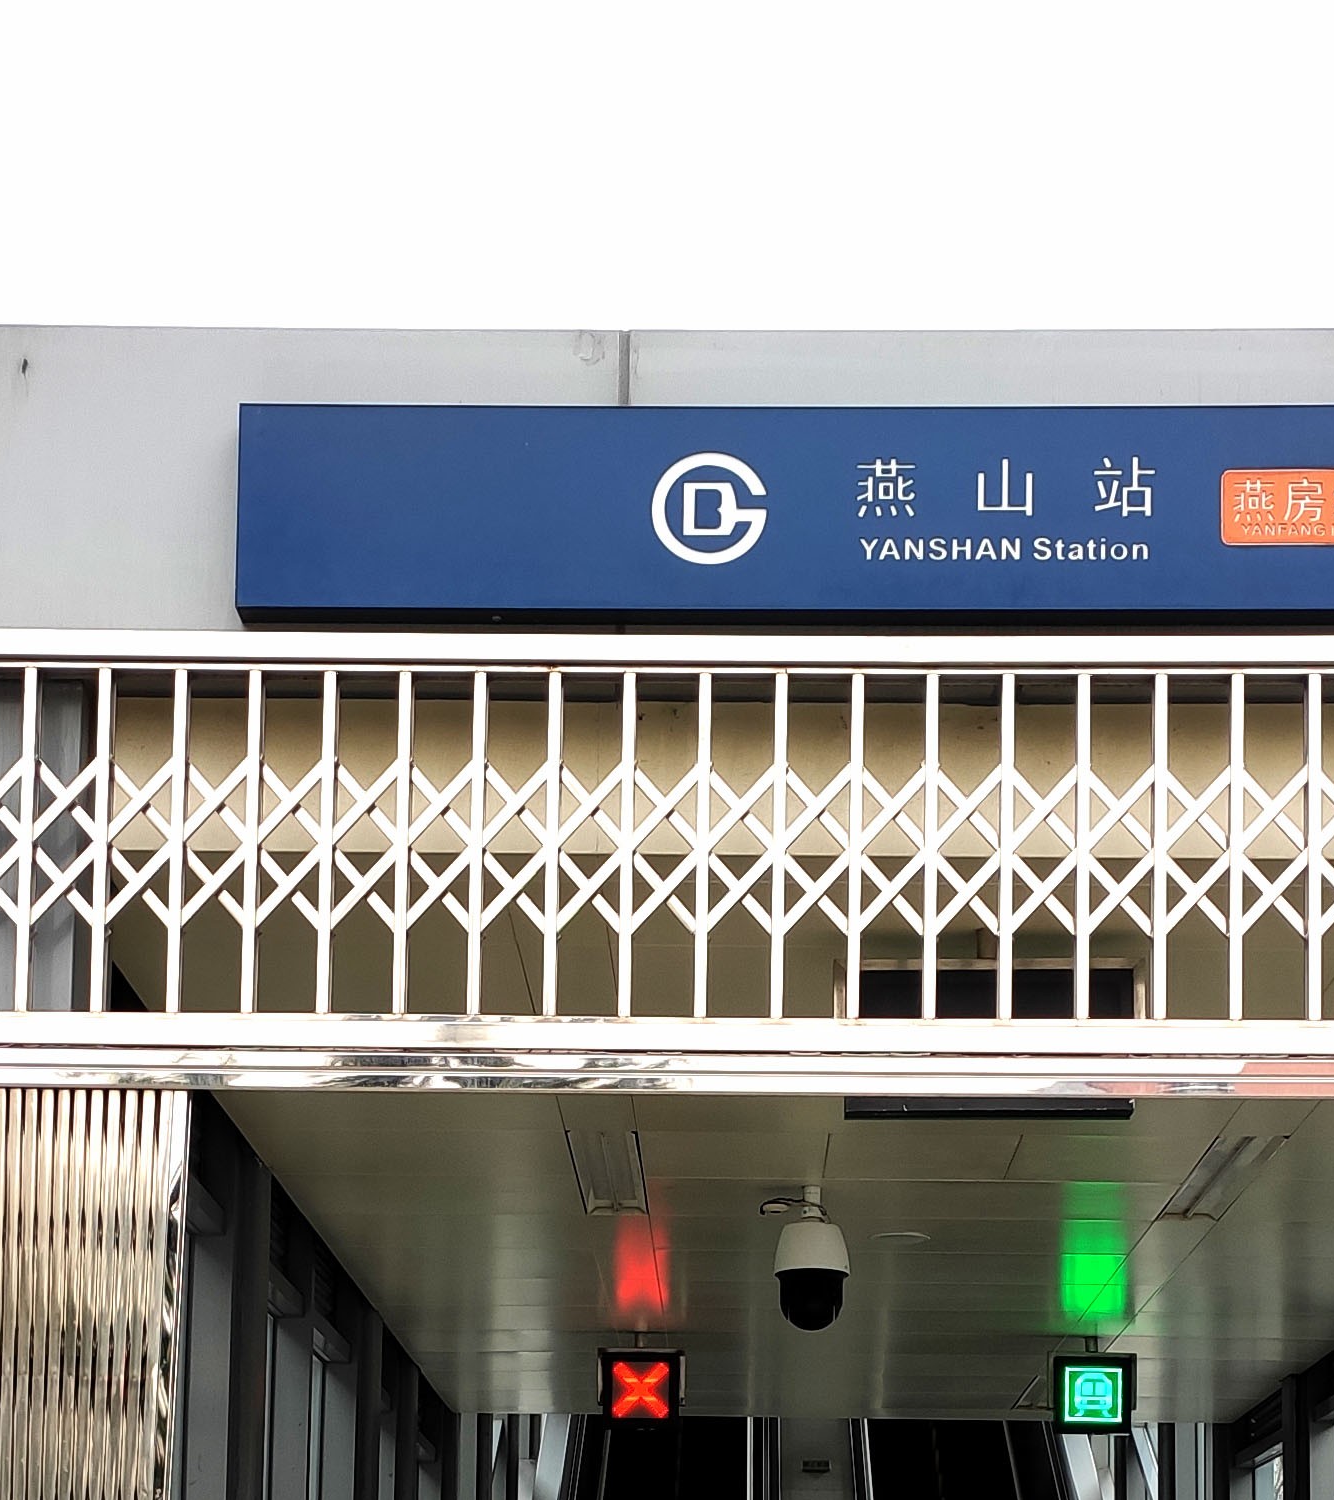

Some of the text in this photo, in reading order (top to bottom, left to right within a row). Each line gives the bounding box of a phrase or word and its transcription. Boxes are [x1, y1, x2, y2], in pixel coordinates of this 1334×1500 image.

[856, 456, 1156, 518] 燕山站
[1241, 523, 1326, 537] YANFANG
[860, 537, 1150, 561] YANSHAN Station
